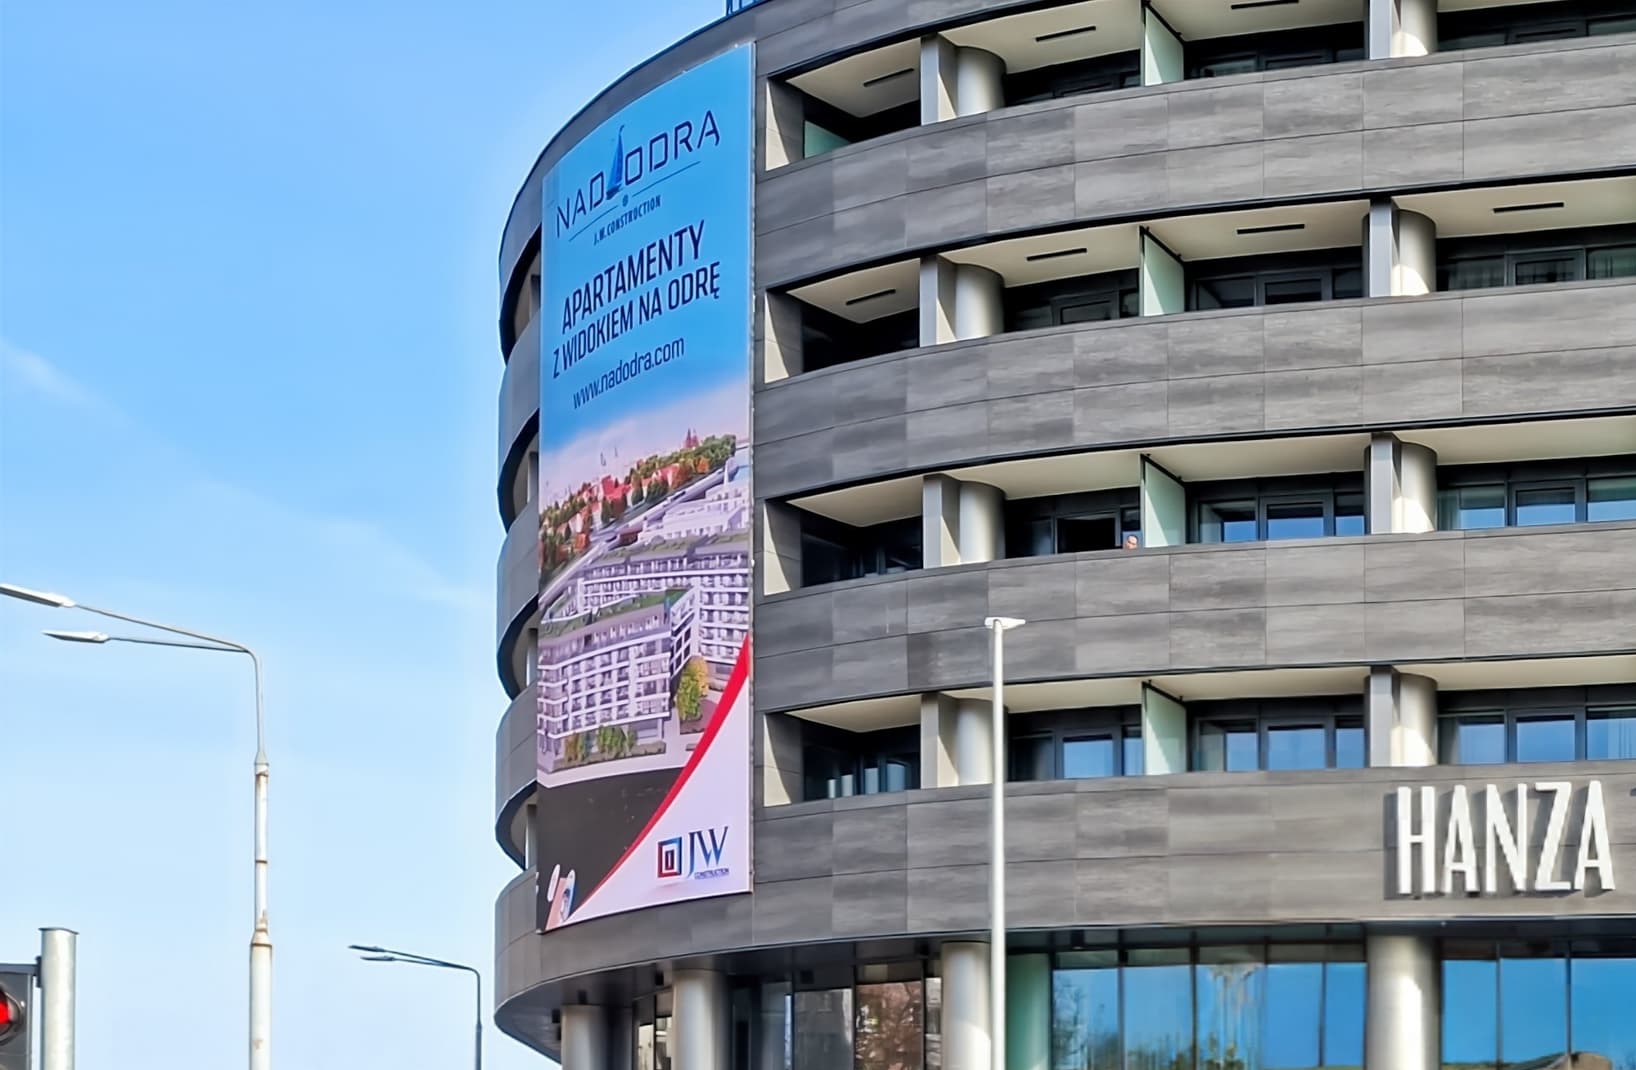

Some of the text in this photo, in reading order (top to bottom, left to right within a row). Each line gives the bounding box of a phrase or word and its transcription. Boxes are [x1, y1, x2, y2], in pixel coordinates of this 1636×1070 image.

[553, 261, 721, 380] Z WIDOKIEM NA ODRĘ
[562, 219, 705, 335] APARTAMENTY
[573, 338, 685, 409] www.nadodra.com
[687, 826, 729, 879] JW
[1395, 780, 1615, 896] HANZA
